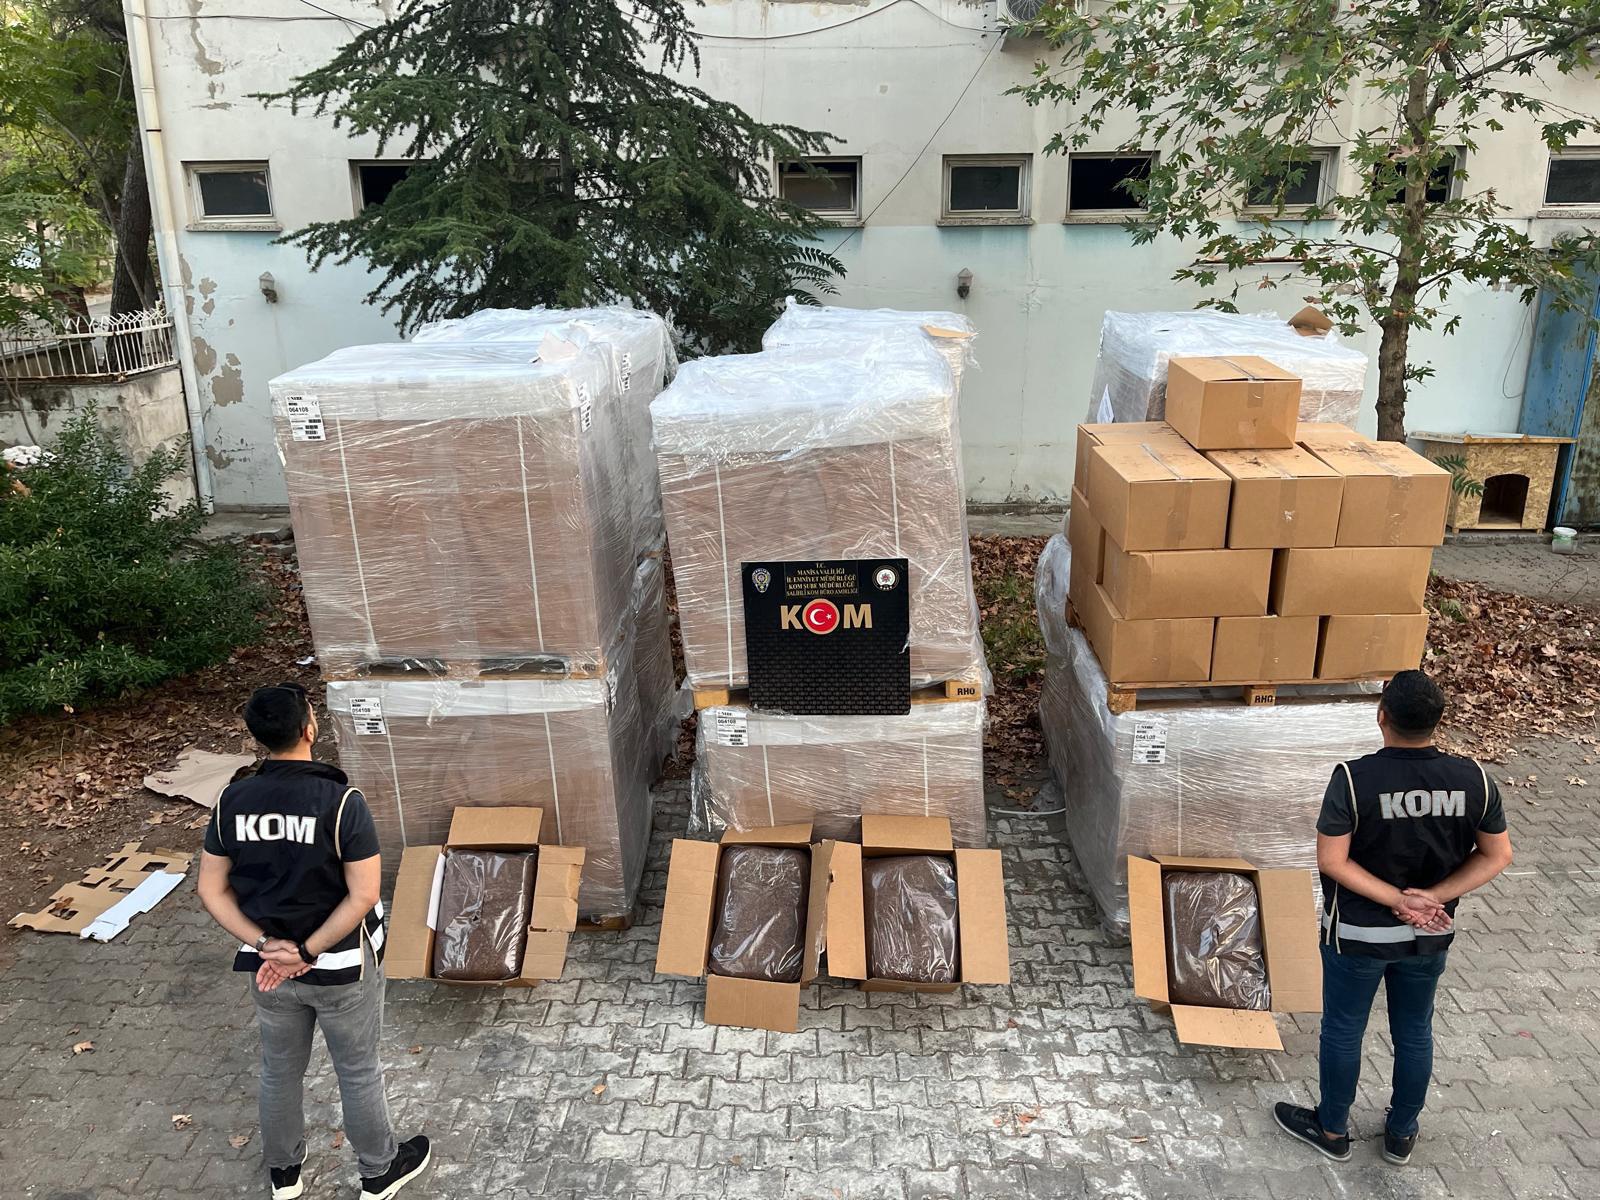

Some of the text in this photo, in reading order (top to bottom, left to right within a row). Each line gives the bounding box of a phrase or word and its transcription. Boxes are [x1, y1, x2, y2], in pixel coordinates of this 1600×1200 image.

[957, 687, 976, 696] RHO
[1254, 694, 1274, 704] RHO
[1379, 789, 1466, 820] KOM
[235, 813, 317, 845] KOM
